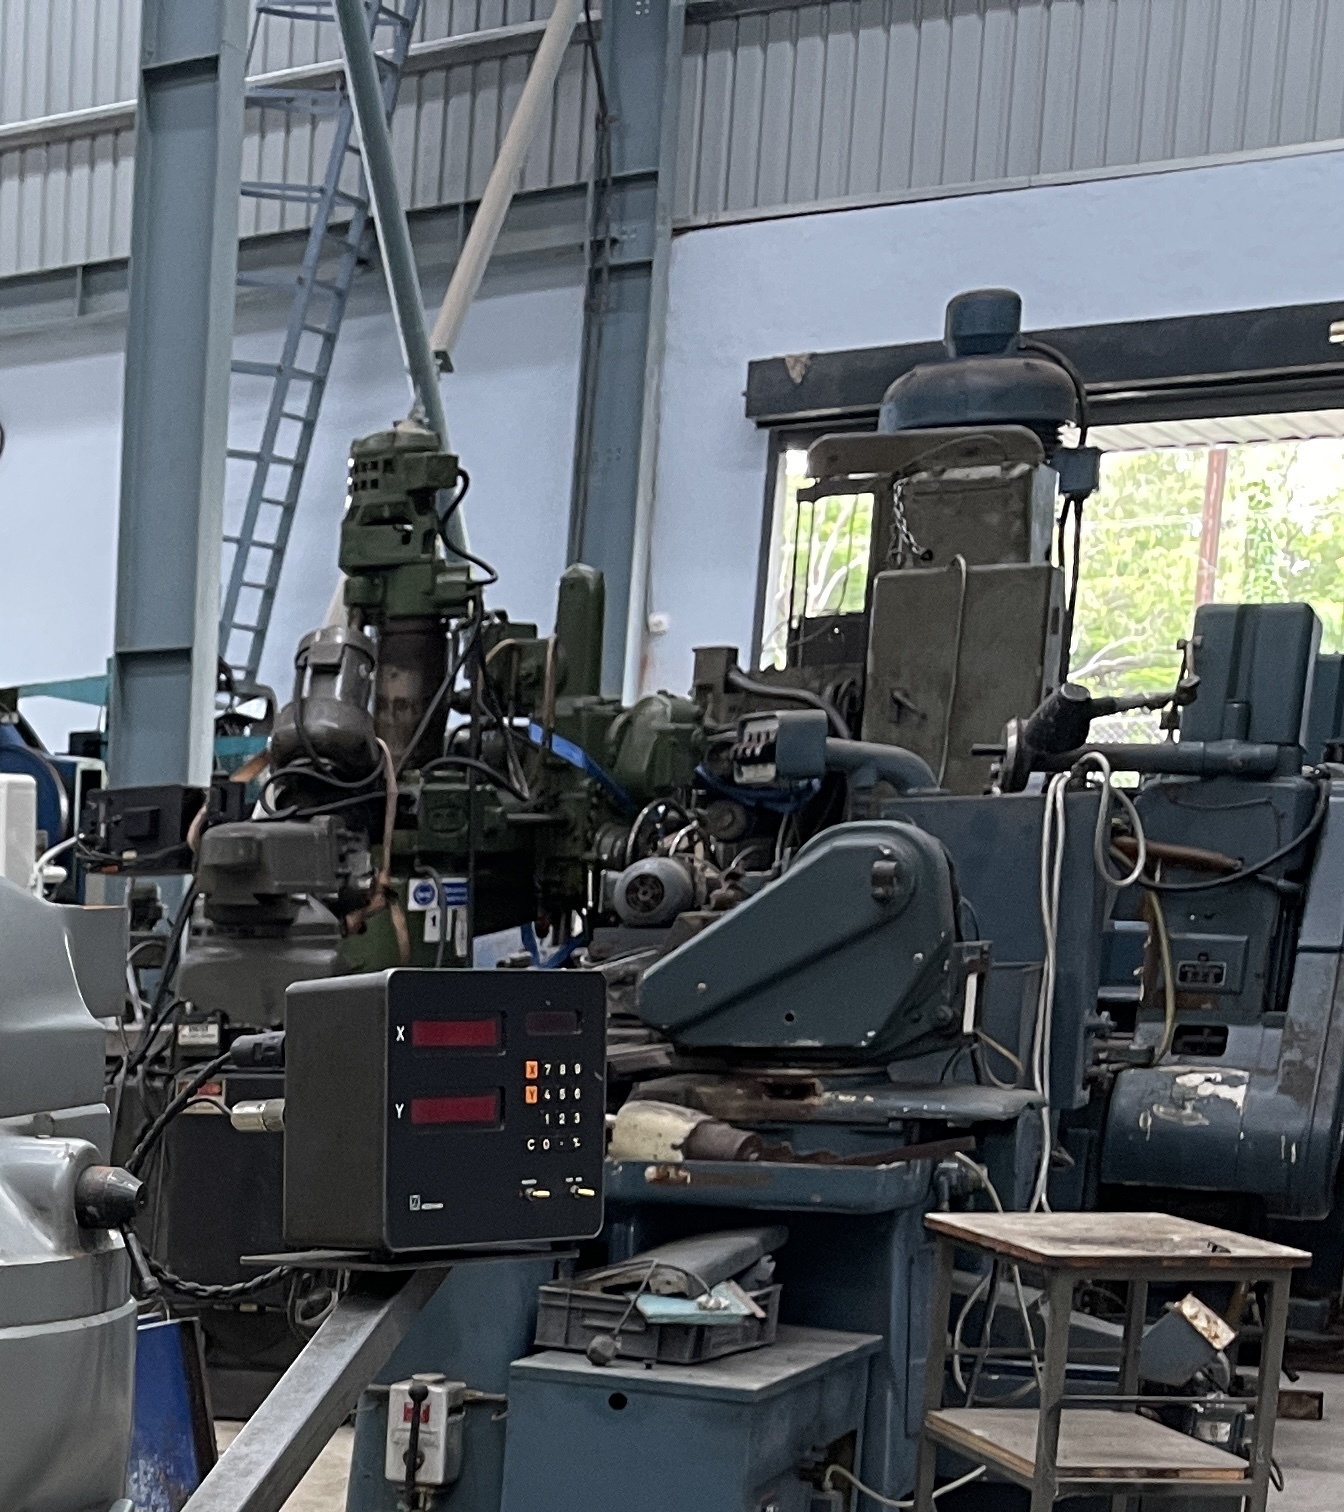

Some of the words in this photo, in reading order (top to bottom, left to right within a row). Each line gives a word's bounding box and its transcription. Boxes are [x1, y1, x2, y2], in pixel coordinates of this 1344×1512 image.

[396, 1026, 405, 1041] X
[544, 1064, 551, 1075] 7
[560, 1064, 566, 1075] 8
[544, 1089, 551, 1100] 4
[559, 1089, 566, 1100] 5
[575, 1088, 580, 1099] 6
[396, 1103, 404, 1119] Y
[545, 1113, 550, 1124] 1
[559, 1113, 565, 1124] 2
[574, 1112, 580, 1124] 3
[527, 1139, 535, 1150] C
